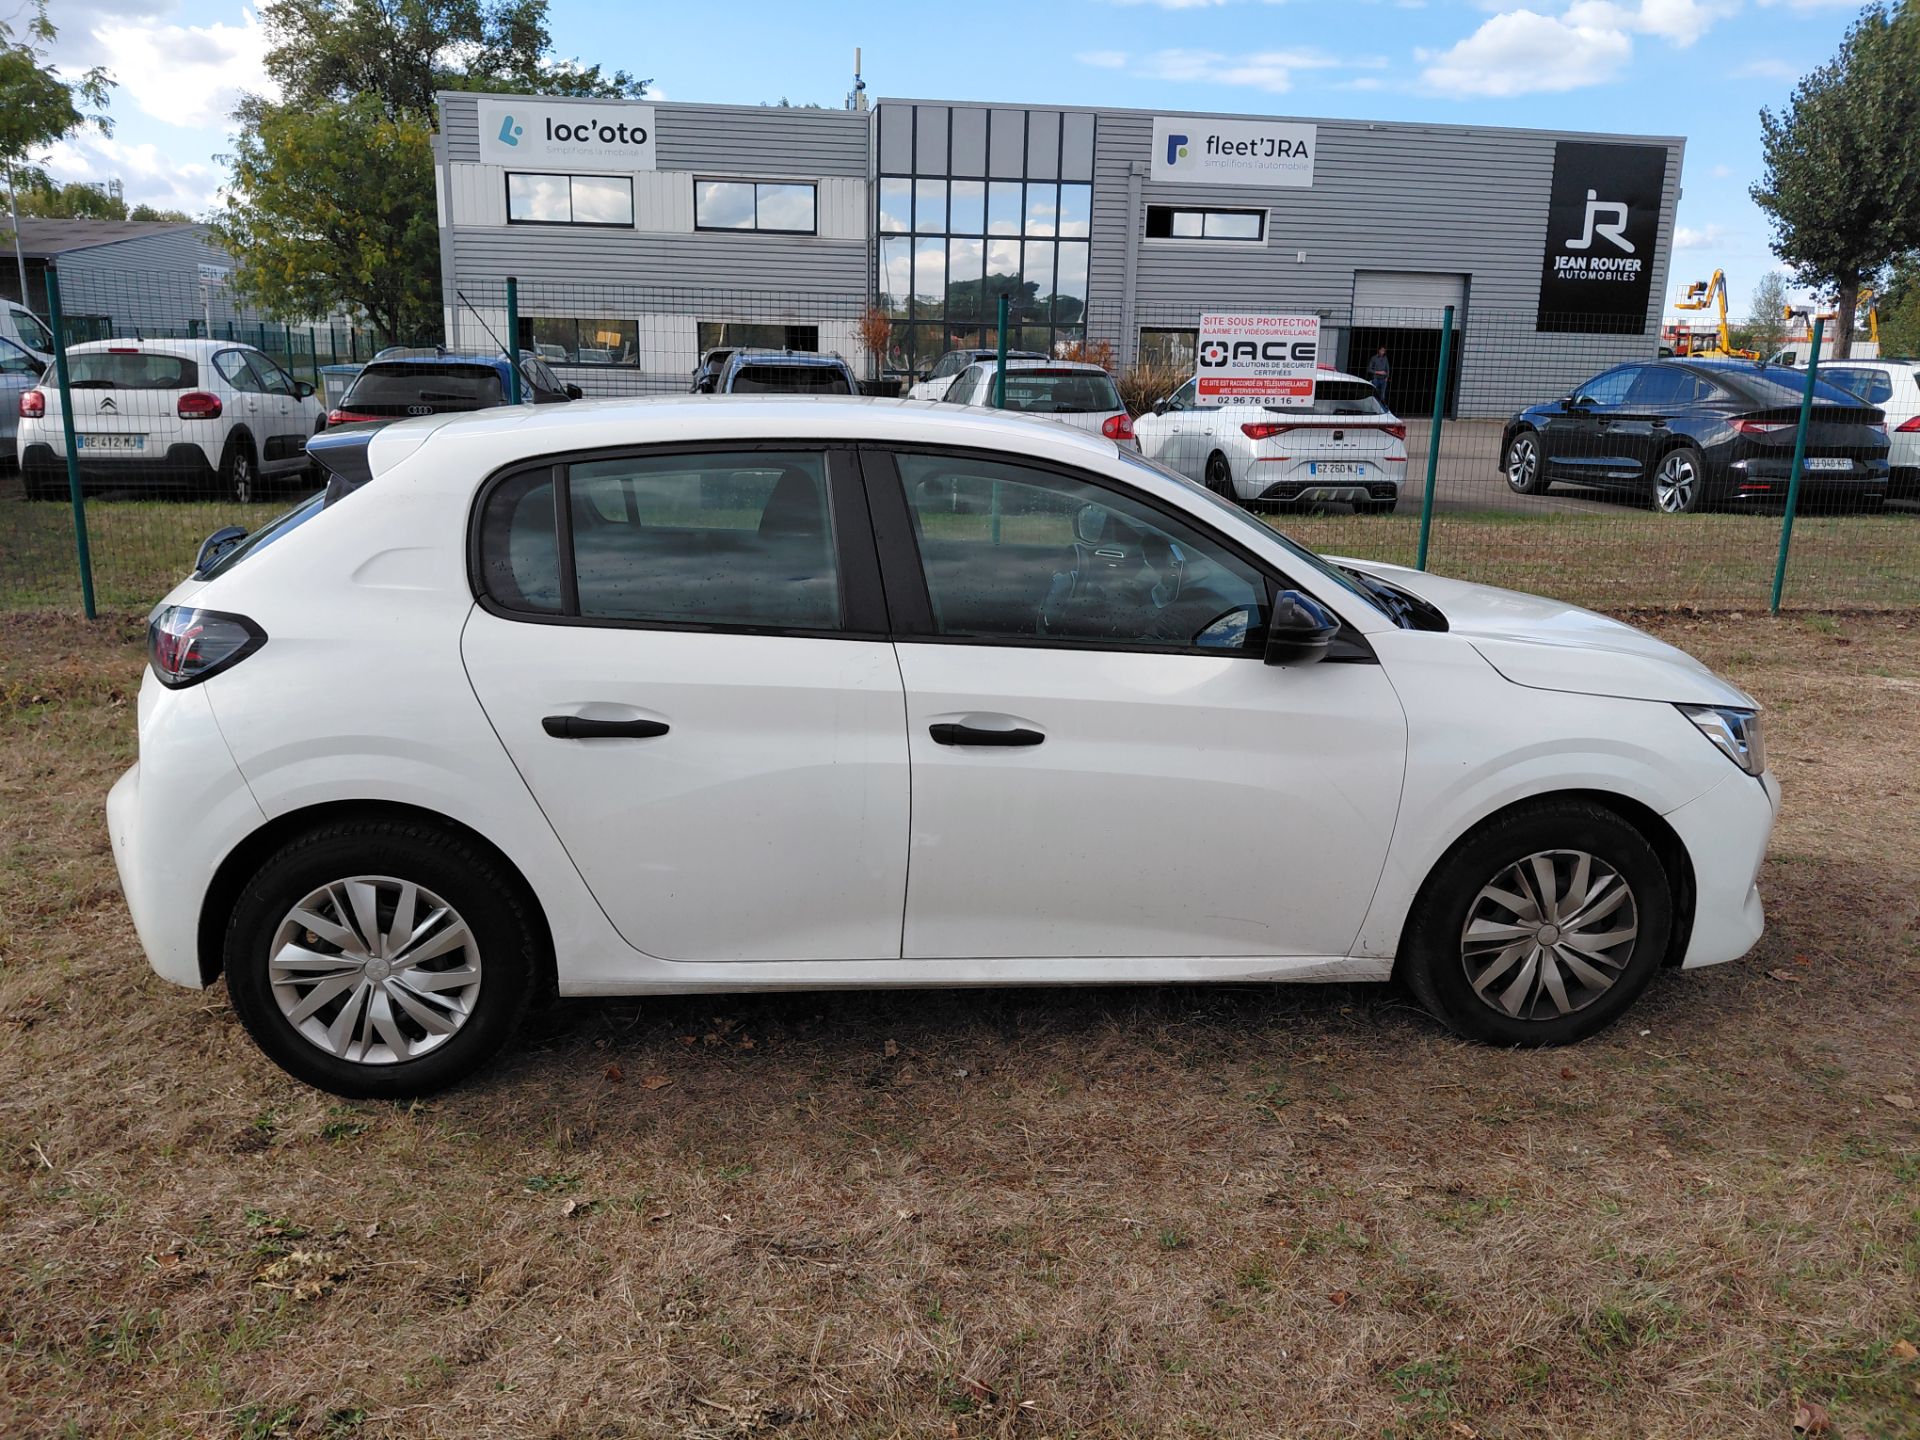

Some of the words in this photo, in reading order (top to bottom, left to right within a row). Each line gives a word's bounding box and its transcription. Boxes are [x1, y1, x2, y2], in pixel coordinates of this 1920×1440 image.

[546, 117, 647, 145] loc'oto
[1206, 135, 1309, 159] fleet'JRA
[1554, 256, 1587, 270] JEAN
[1590, 257, 1642, 272] ROUYER
[1558, 270, 1636, 281] AUTOMOBILES
[1203, 317, 1225, 326] SITE
[1227, 317, 1254, 326] SOUS
[1256, 318, 1318, 327] PROTECTION
[1232, 341, 1317, 361] ACE
[1217, 396, 1230, 404] 02
[1233, 397, 1246, 405] 96
[1249, 397, 1261, 405] 76
[1264, 397, 1276, 405] 61
[1280, 397, 1292, 405] 16
